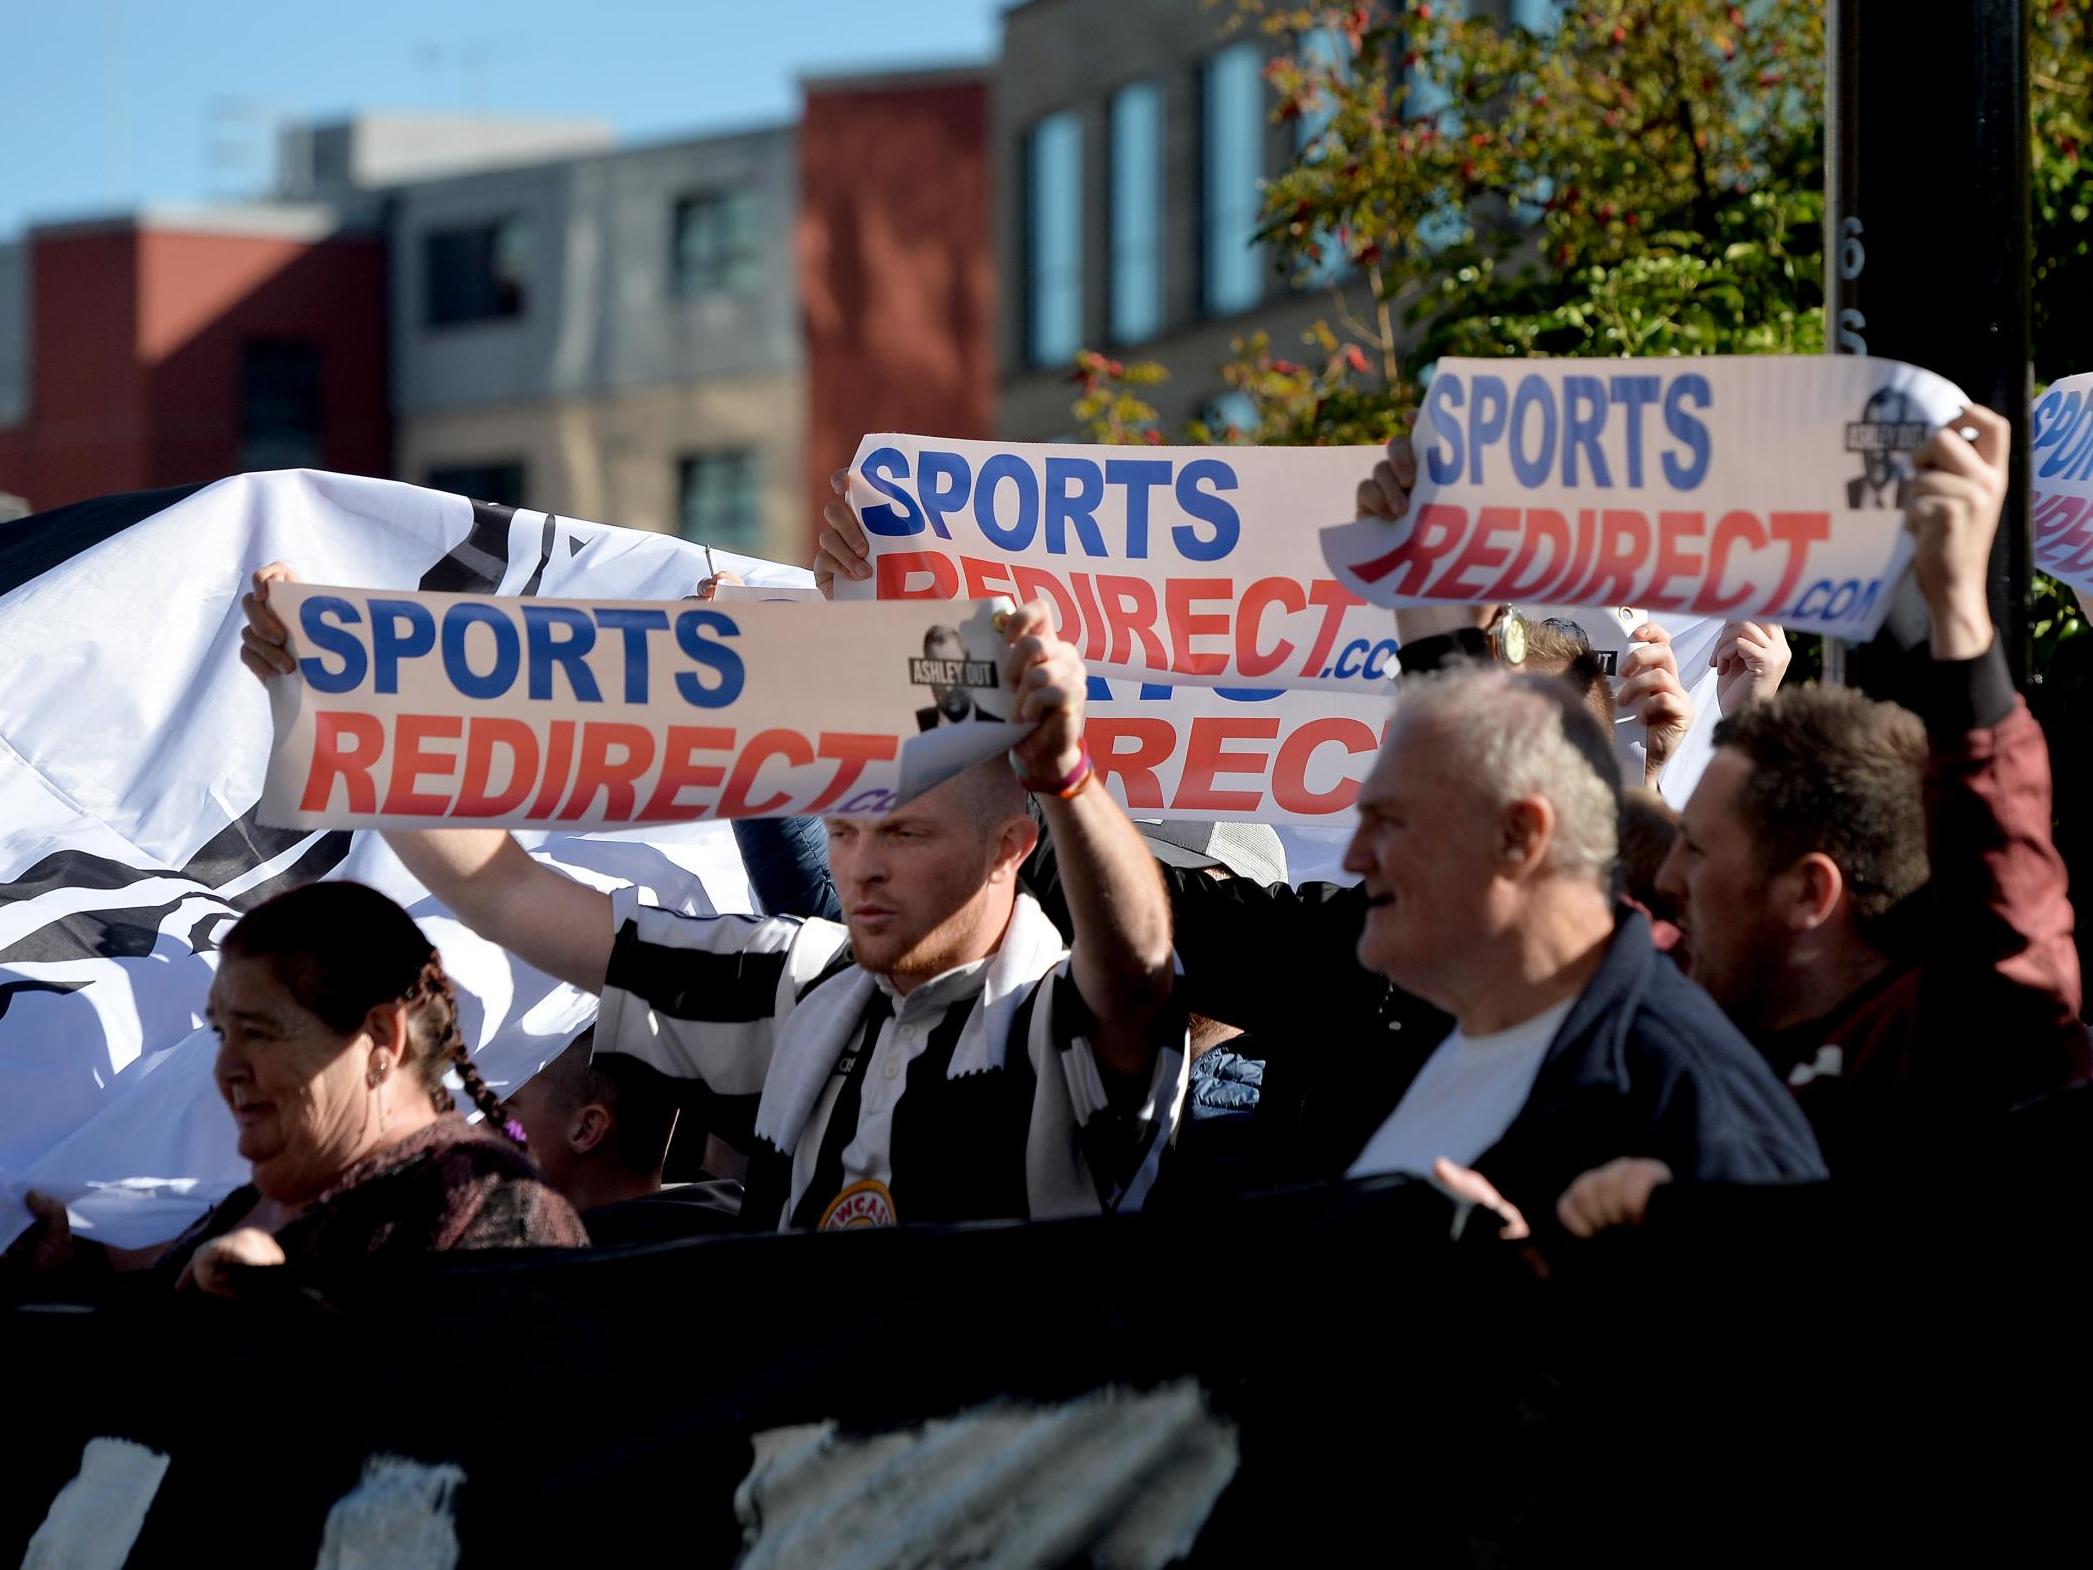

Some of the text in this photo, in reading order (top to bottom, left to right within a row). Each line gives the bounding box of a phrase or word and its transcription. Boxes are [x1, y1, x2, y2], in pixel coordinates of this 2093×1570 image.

[1426, 373, 1714, 491] SPORTS
[861, 447, 1240, 561] SPORTS
[300, 595, 745, 708] SPORTS
[913, 658, 993, 687] ASHLEY OUT
